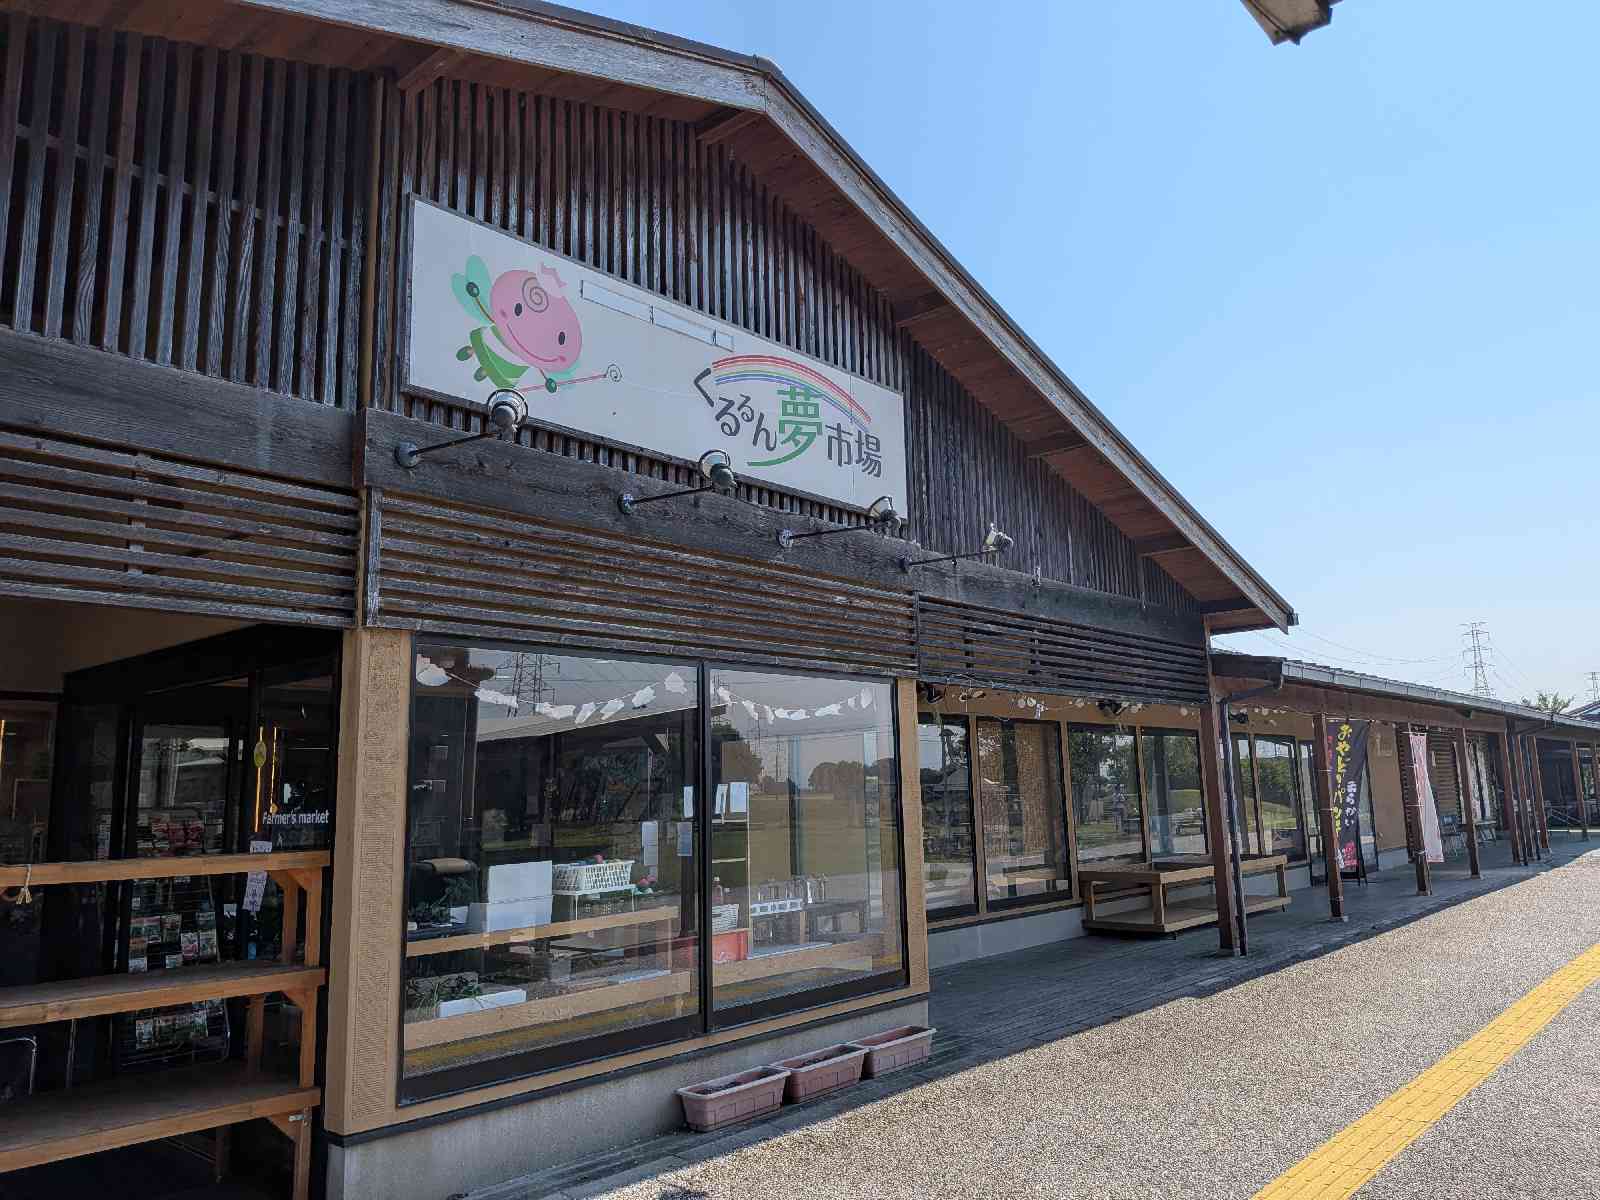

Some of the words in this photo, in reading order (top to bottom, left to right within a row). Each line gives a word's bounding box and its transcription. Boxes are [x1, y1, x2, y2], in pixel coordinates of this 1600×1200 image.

[694, 368, 882, 478] くるるん夢市場
[262, 810, 297, 825] Farmer's
[298, 809, 330, 824] market
